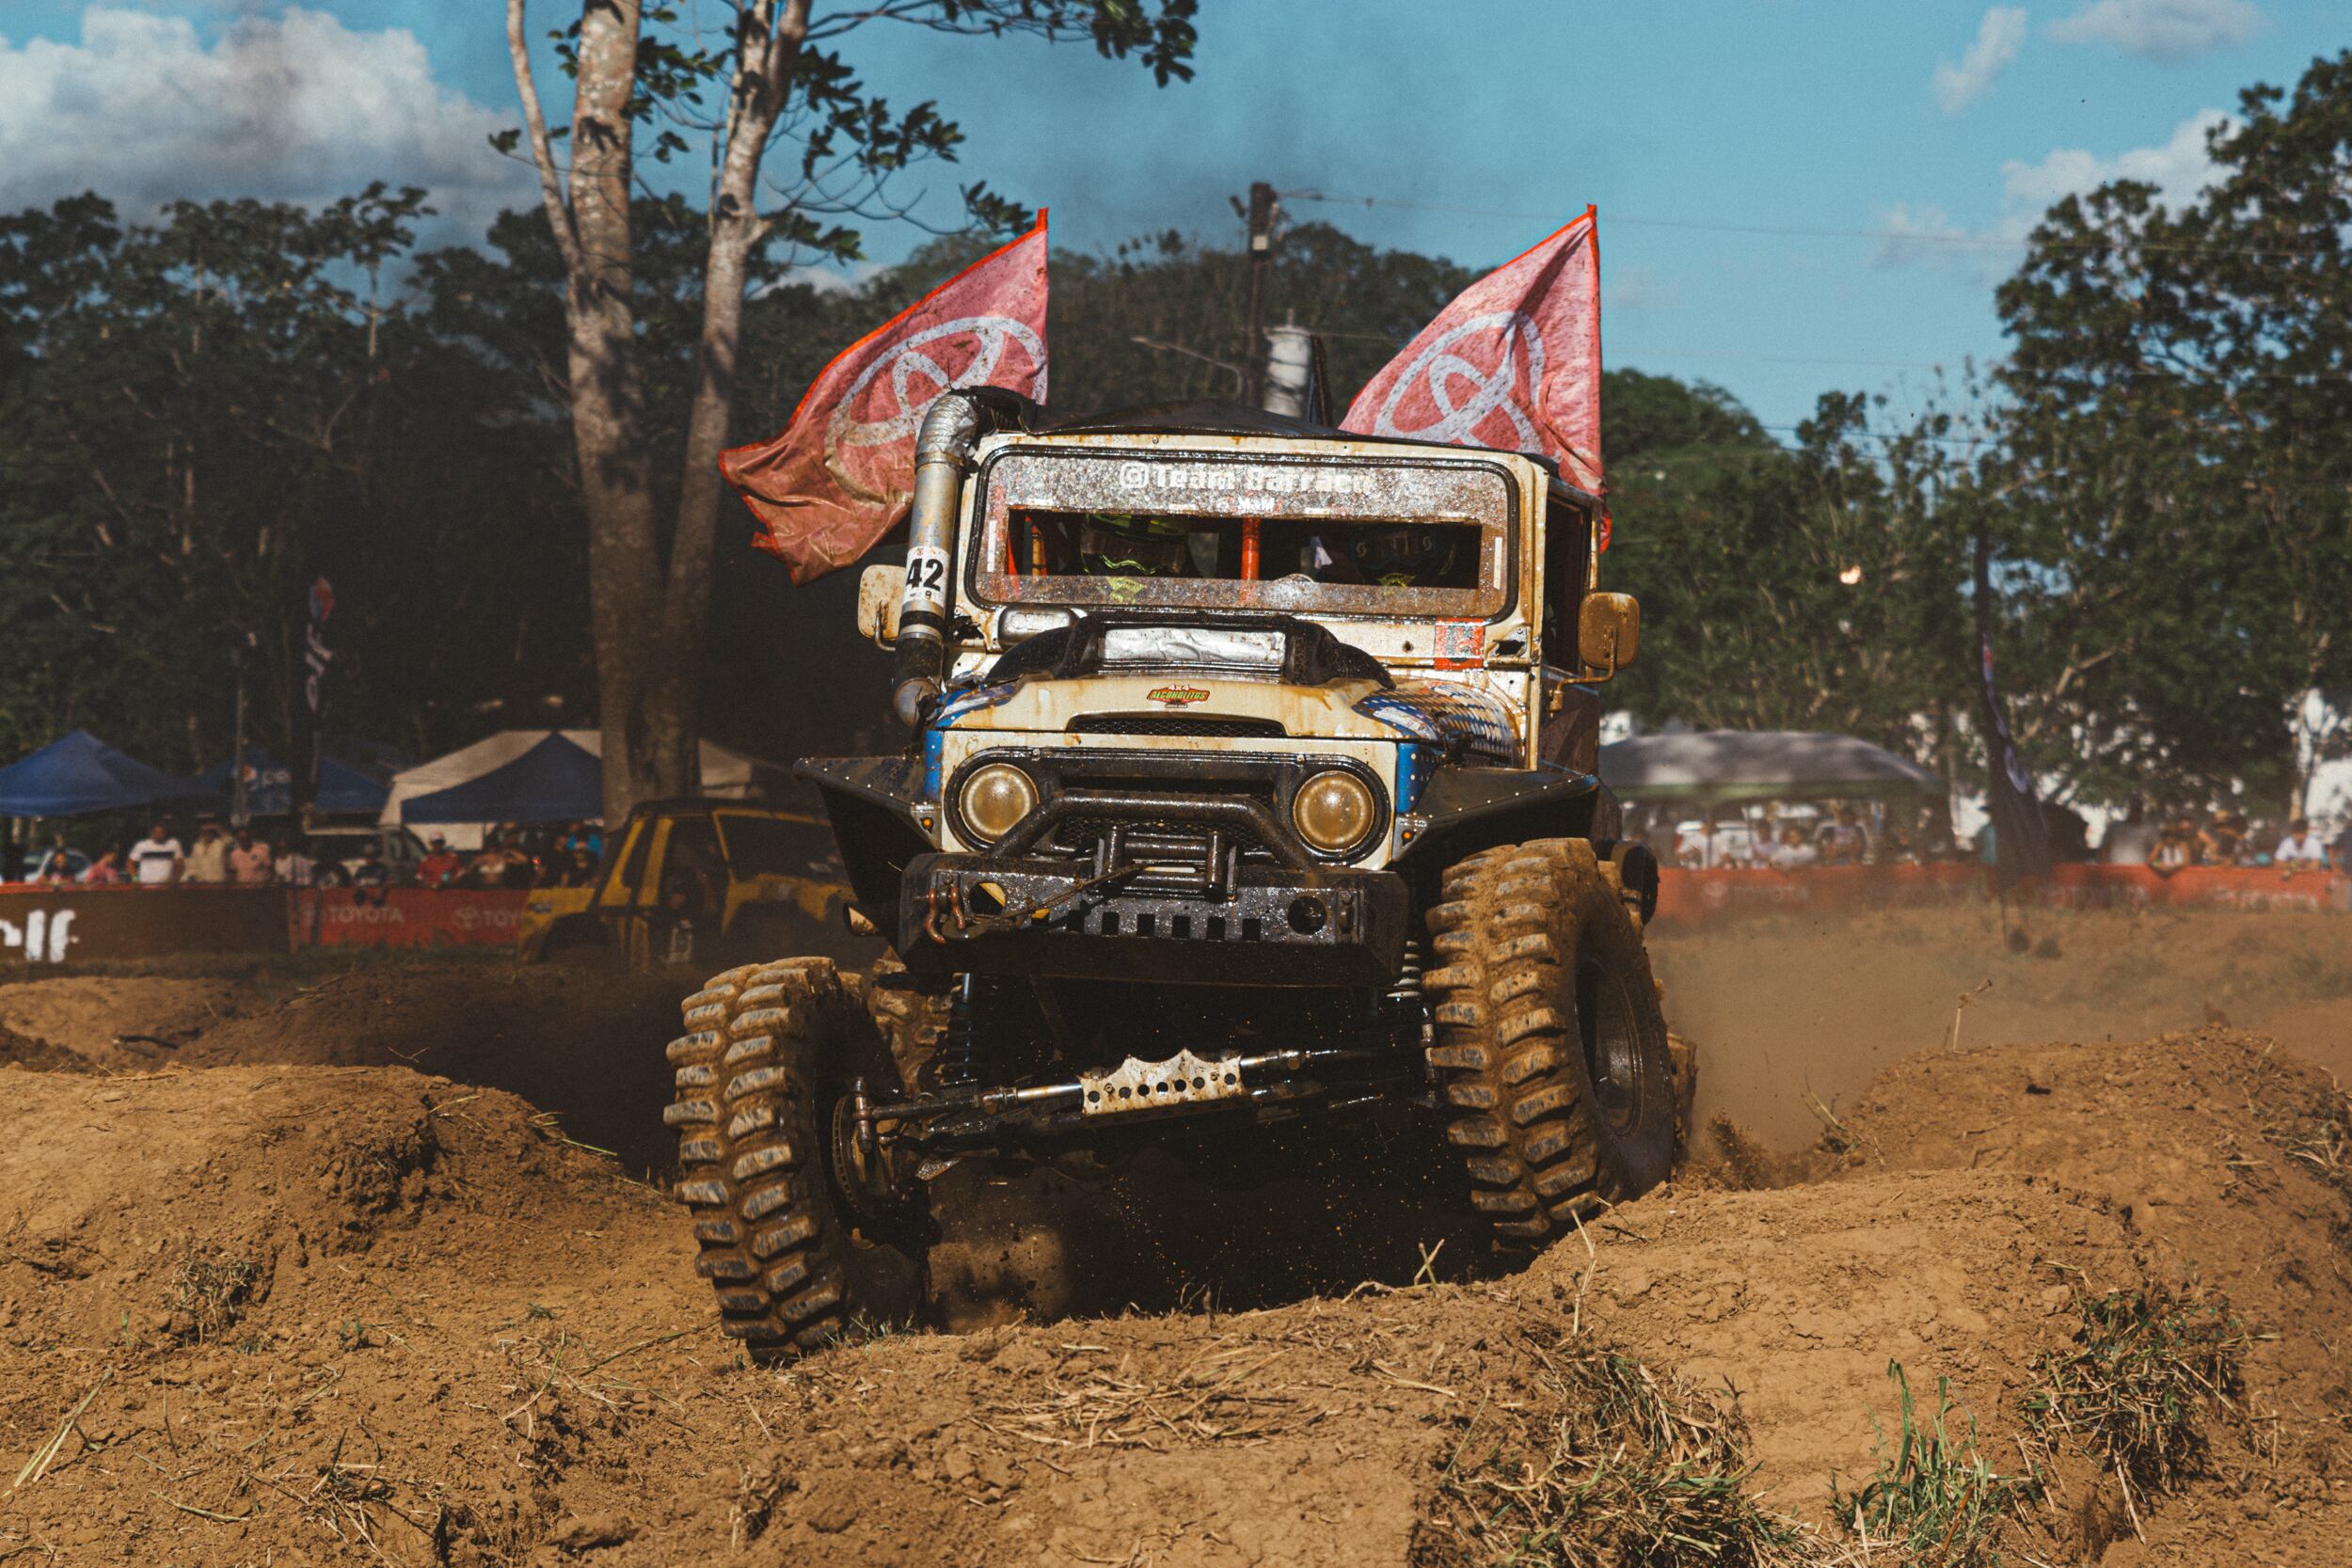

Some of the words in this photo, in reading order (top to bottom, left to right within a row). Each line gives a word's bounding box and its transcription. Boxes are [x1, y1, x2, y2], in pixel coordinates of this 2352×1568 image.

[906, 558, 945, 592] 42
[330, 907, 404, 924] TOYOTA
[484, 909, 519, 927] TOY
